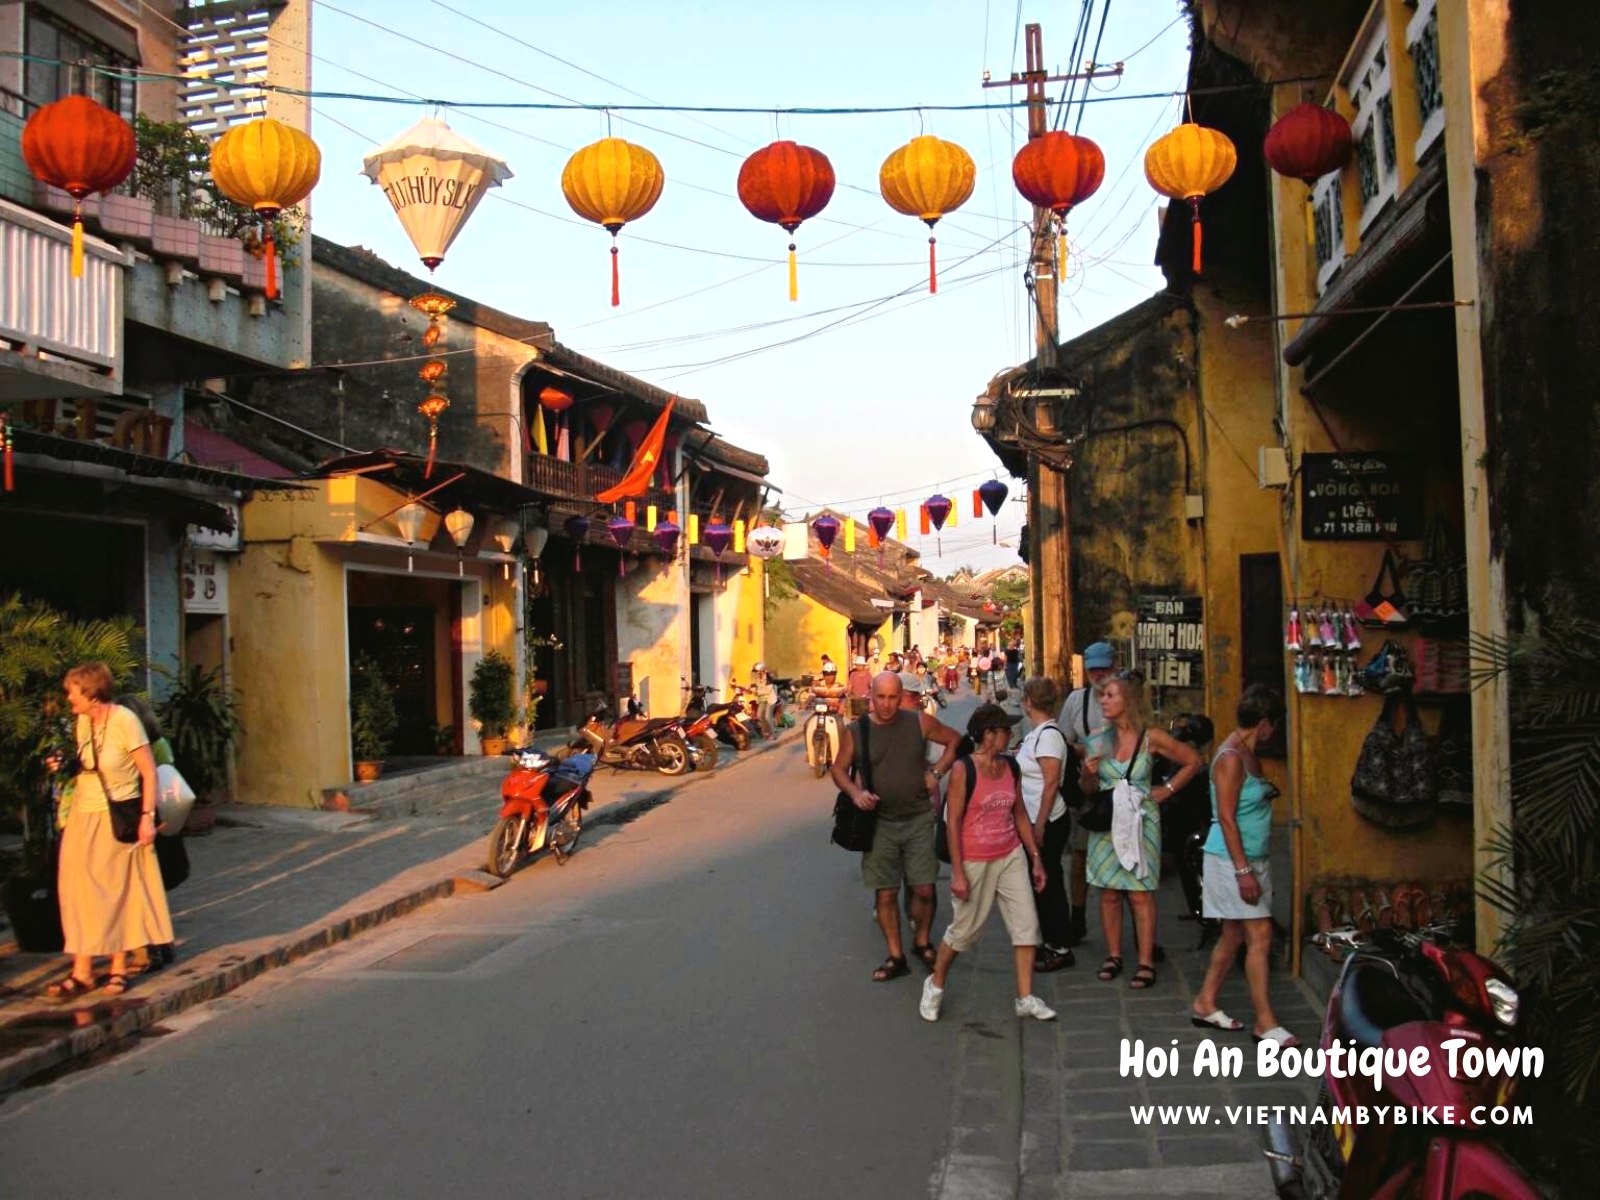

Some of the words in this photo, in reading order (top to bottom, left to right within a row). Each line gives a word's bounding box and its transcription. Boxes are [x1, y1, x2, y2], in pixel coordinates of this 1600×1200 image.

[442, 178, 478, 211] SILK
[1155, 596, 1184, 614] BÁN
[1177, 623, 1204, 650] HOA
